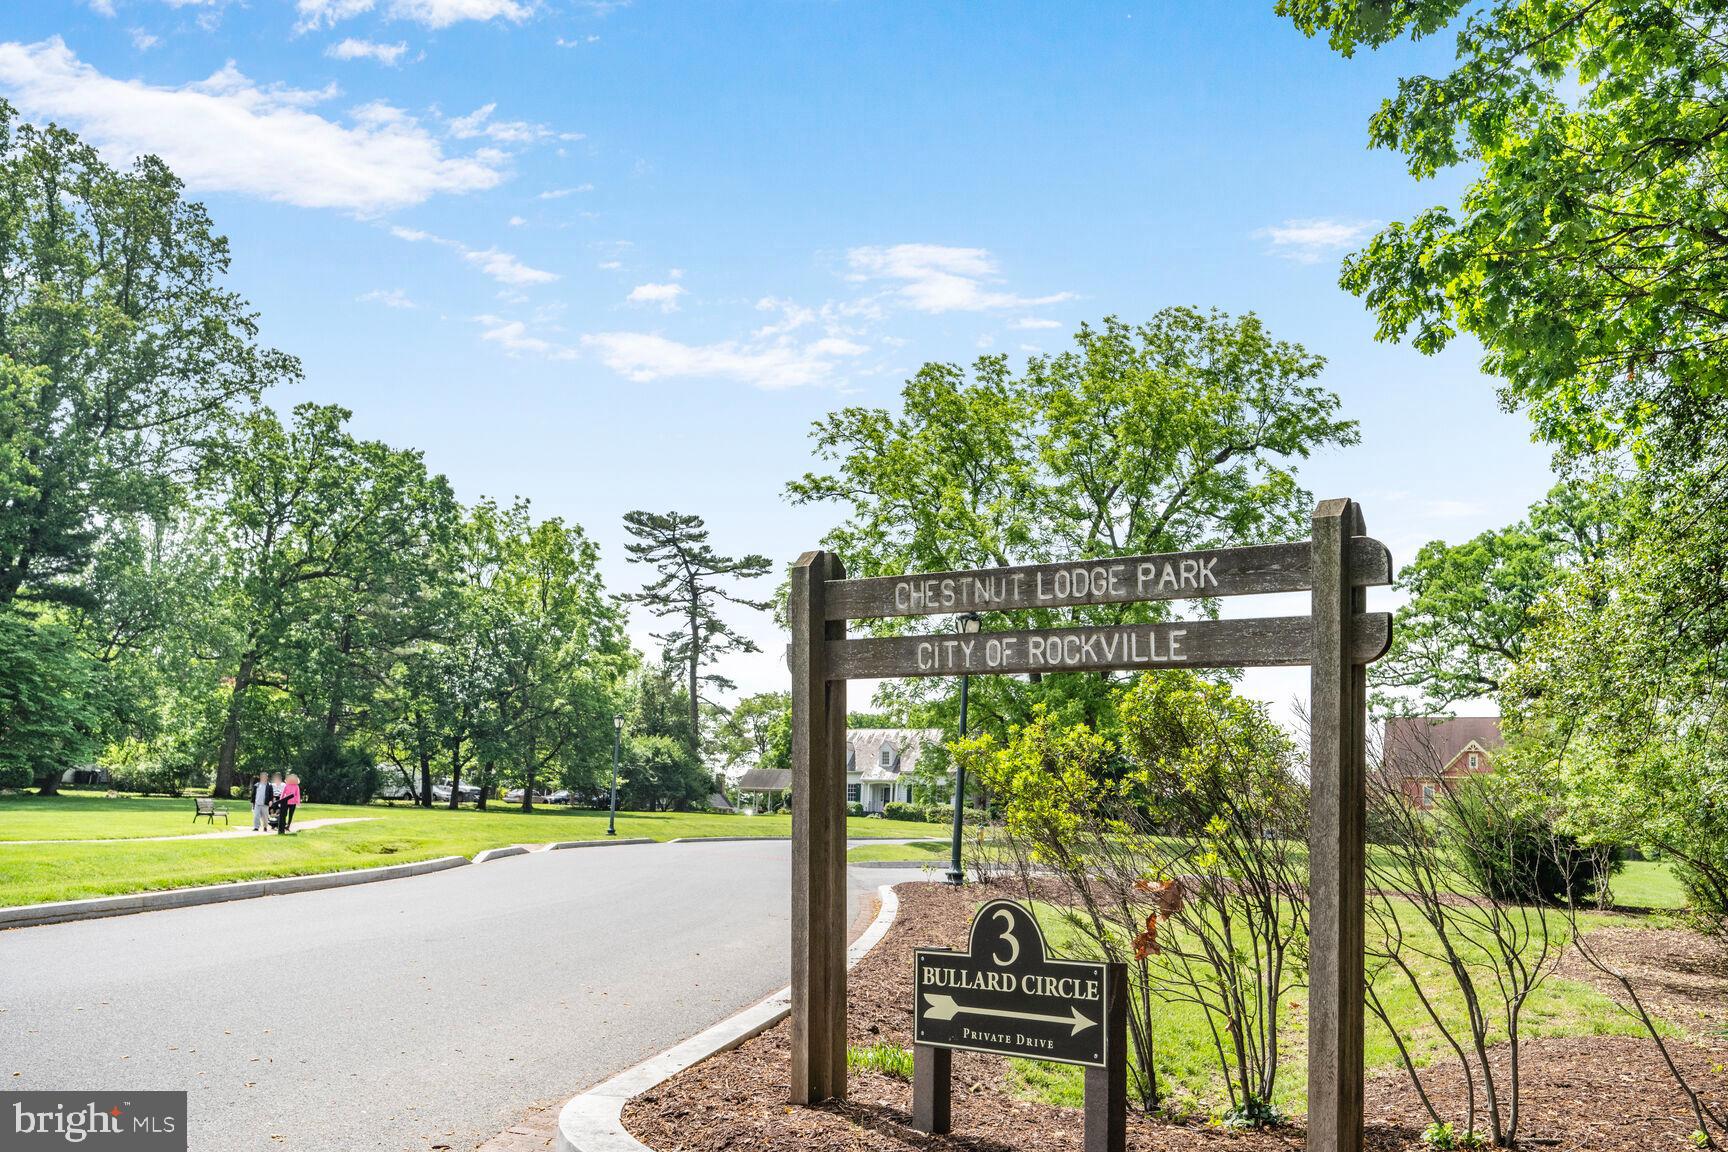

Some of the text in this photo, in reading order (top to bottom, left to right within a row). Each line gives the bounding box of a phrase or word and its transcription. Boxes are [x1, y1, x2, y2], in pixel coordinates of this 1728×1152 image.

[895, 557, 1218, 610] CHESTNUT LODGE PARK
[917, 629, 1187, 670] CITY OF ROCKVILLE
[992, 908, 1020, 966] 3
[922, 966, 1100, 1001] BULLARD CIRCLE
